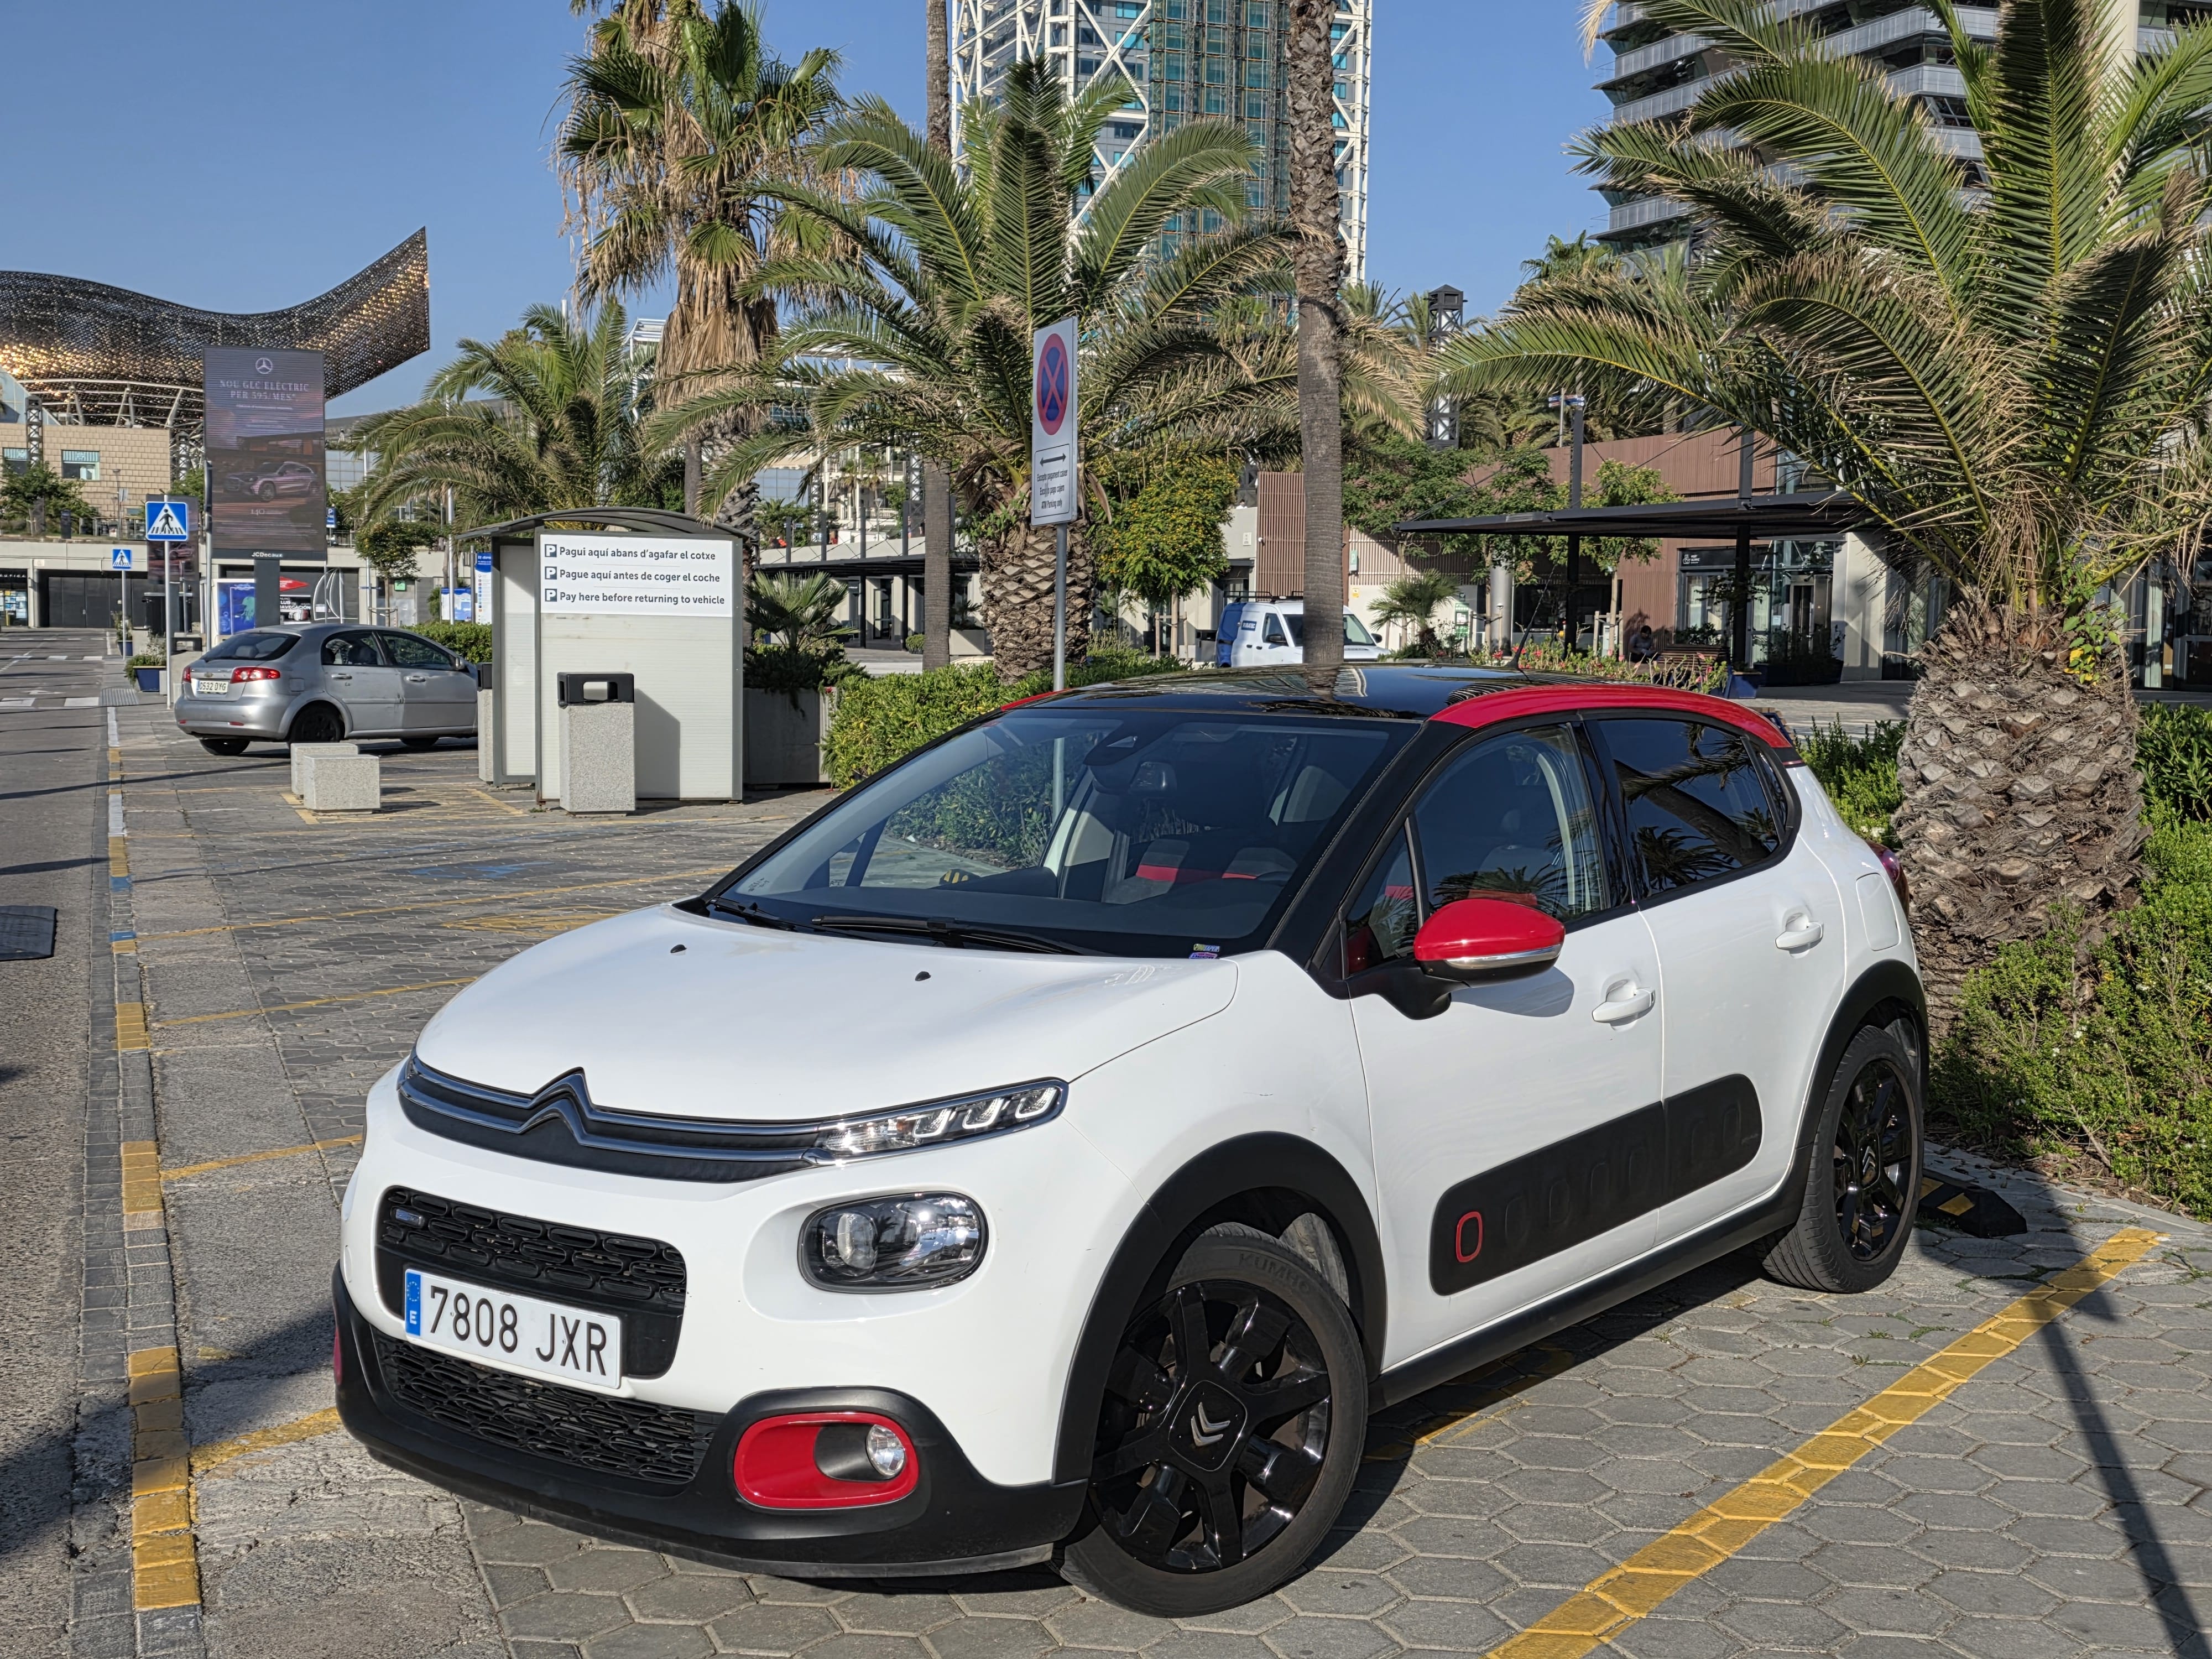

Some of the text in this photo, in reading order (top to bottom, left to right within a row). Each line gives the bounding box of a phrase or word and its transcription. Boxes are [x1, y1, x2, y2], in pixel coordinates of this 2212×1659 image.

[230, 390, 248, 399] PER
[560, 546, 586, 558] Pagui
[588, 548, 609, 559] aquí
[611, 548, 638, 557] abans
[680, 551, 688, 559] el
[690, 552, 716, 560] cotxe
[560, 569, 589, 581] Pague
[591, 571, 611, 581] aquí
[613, 572, 639, 580] antes
[640, 572, 652, 580] de
[654, 574, 681, 583] coger
[682, 573, 691, 581] el
[693, 573, 720, 582] coche
[560, 592, 576, 603] Pay
[578, 592, 600, 601] here
[602, 593, 633, 602] before
[635, 594, 679, 605] returning
[692, 595, 724, 604] vehicle
[409, 1311, 418, 1324] E
[430, 1285, 607, 1376] 7808 JXR
